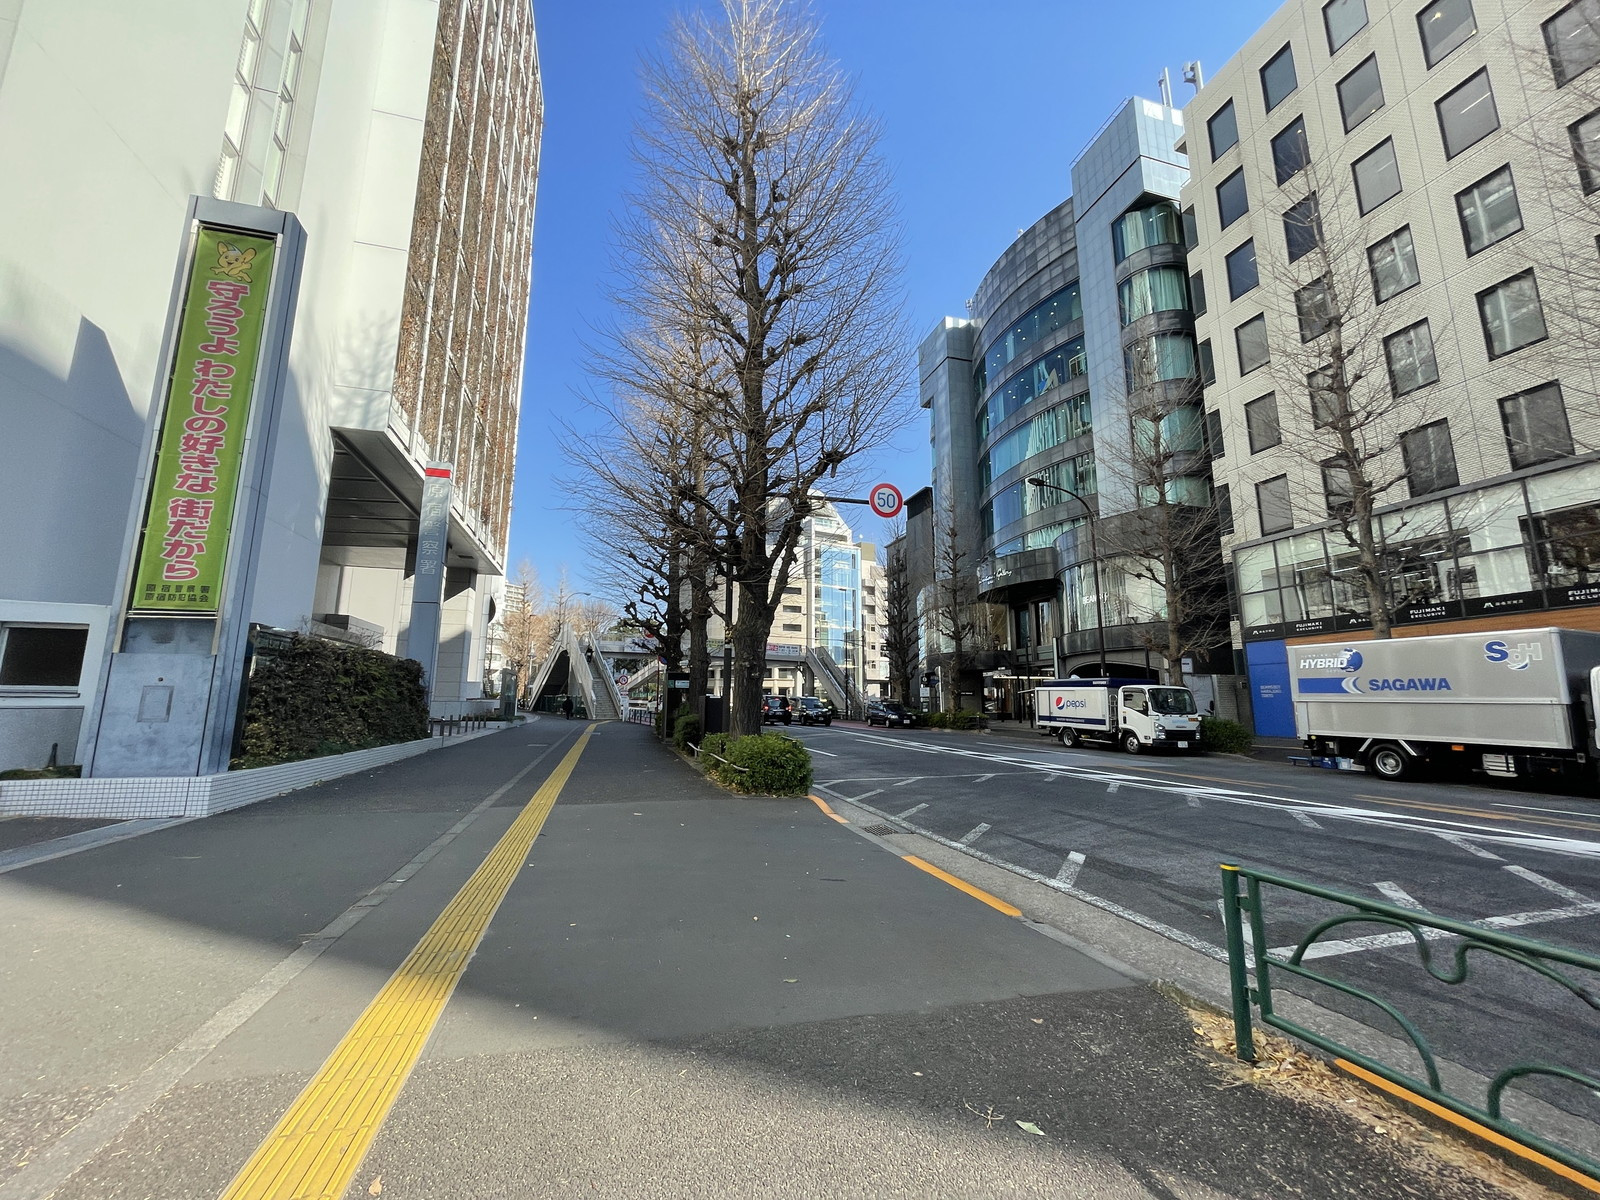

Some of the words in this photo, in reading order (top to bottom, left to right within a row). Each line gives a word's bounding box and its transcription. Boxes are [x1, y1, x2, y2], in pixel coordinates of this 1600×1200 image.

[200, 280, 250, 357] 守ろうよ
[174, 358, 236, 494] わたしの好きな
[877, 492, 896, 508] 50
[419, 483, 444, 575] 原宿警察署
[162, 496, 213, 582] 街だから
[1568, 588, 1600, 596] FUJIM
[1409, 606, 1446, 615] FUJIMAKI
[1410, 611, 1446, 619] EXCLUSIVE
[1296, 621, 1323, 629] FUJIMAKI
[1300, 657, 1348, 669] HYBRID
[1368, 677, 1452, 691] SAGAWA
[1066, 698, 1087, 710] pepsi
